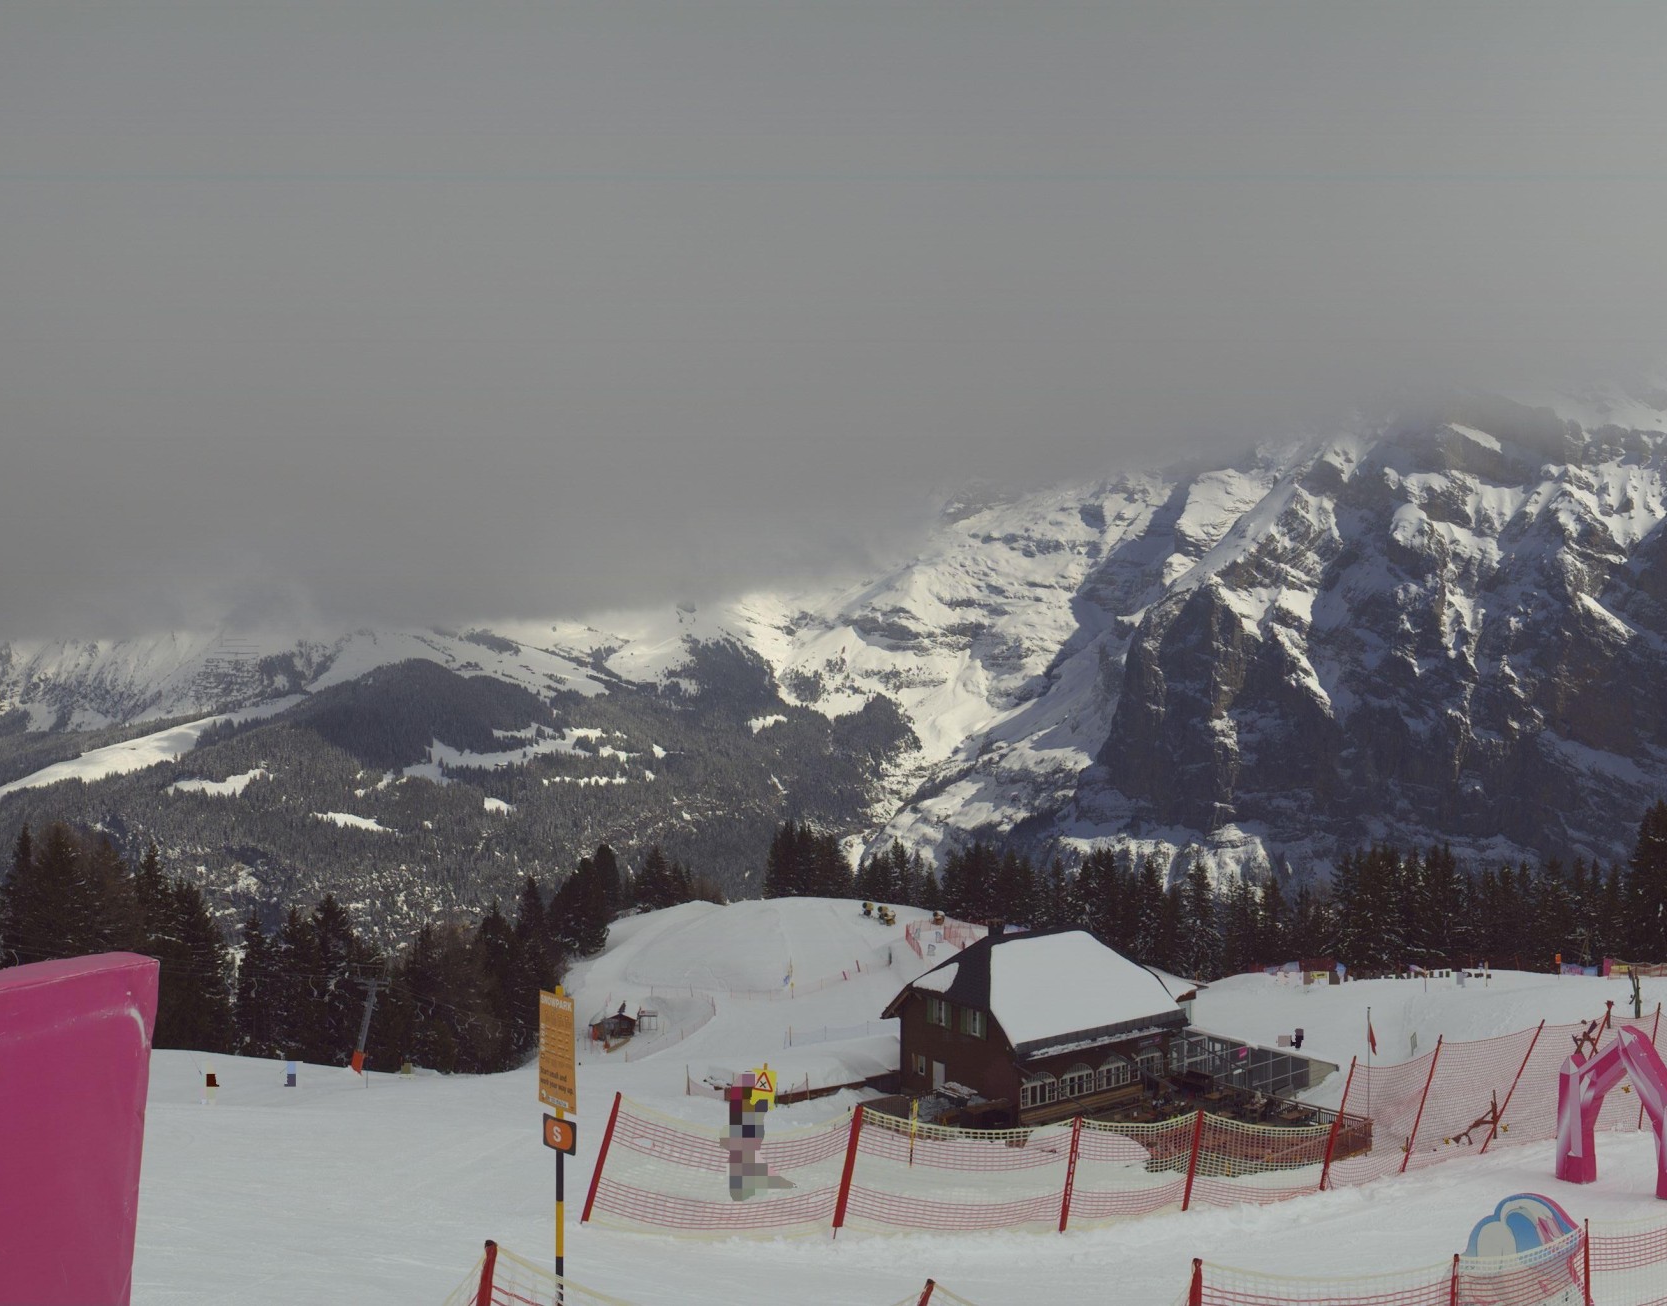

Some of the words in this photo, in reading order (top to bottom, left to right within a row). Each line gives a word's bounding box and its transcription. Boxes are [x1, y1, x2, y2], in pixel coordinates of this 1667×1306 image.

[540, 994, 572, 1012] SNOWPARK
[540, 1066, 549, 1075] Start
[550, 1070, 559, 1079] small
[540, 1077, 549, 1085] work
[558, 1084, 567, 1094] way
[553, 1125, 562, 1142] S
